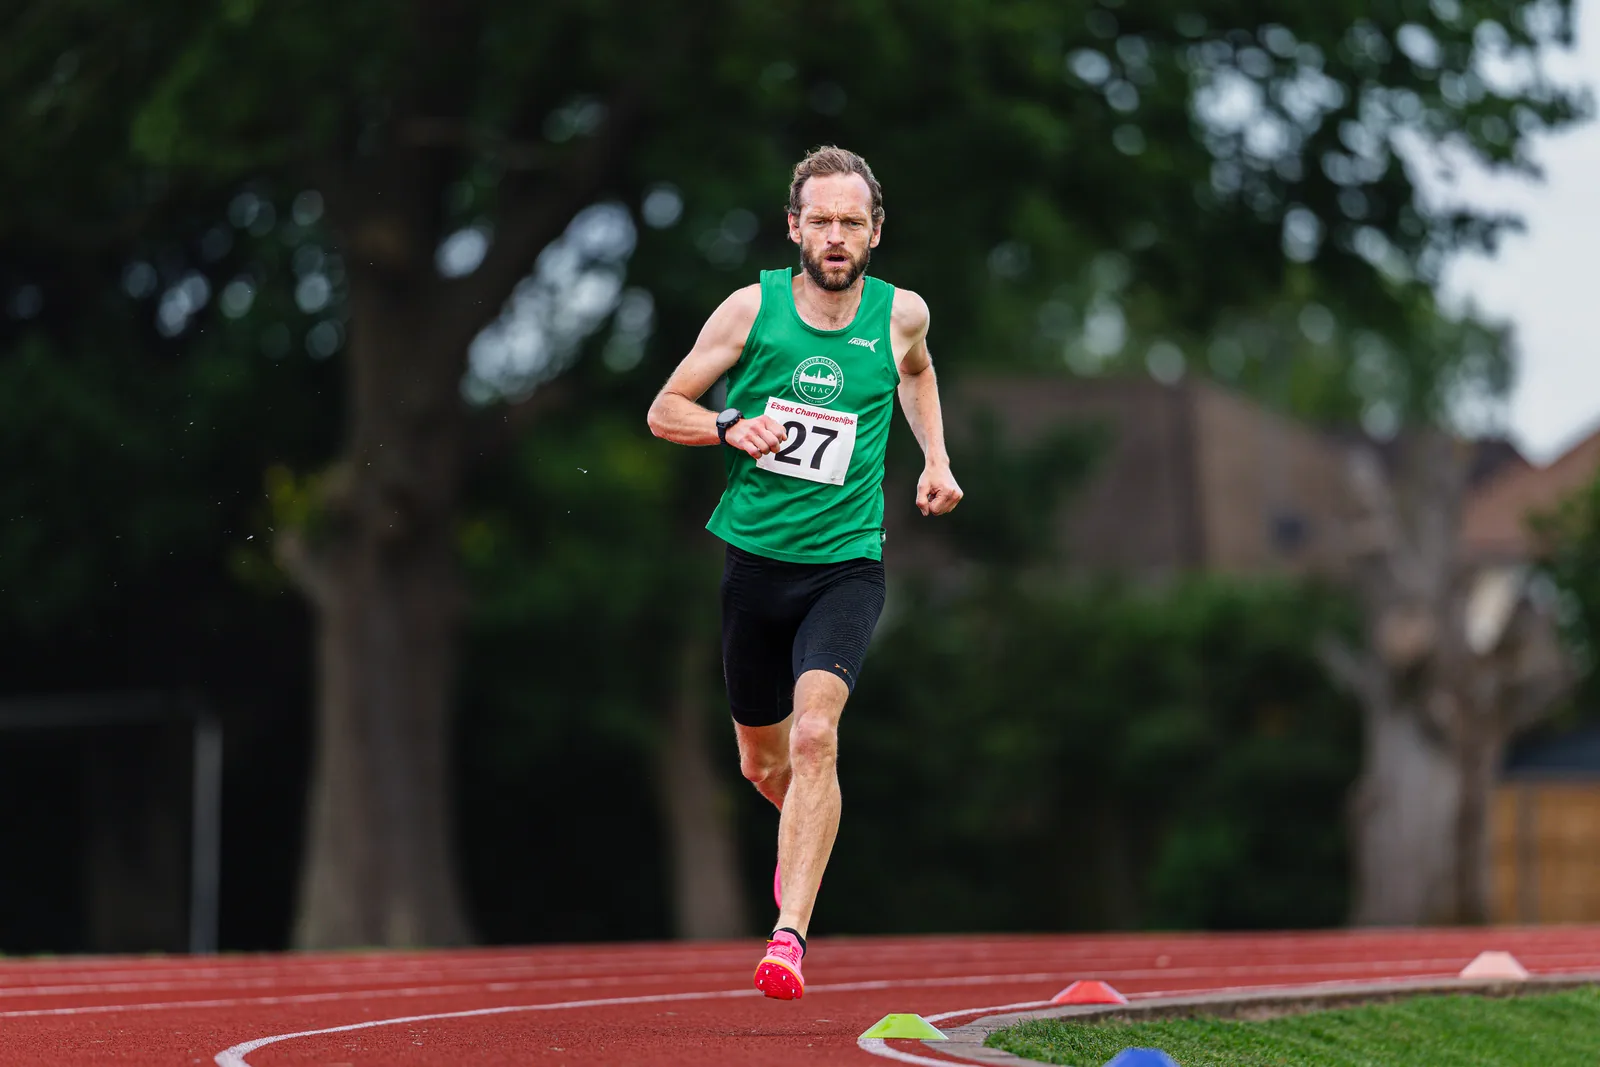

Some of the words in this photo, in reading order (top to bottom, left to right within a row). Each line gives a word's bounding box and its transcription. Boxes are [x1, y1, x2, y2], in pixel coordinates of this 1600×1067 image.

[794, 358, 820, 384] COLCHESTER
[820, 358, 842, 379] HARRIERS
[803, 385, 831, 395] CHAC
[770, 401, 794, 414] Essex
[795, 407, 855, 425] Championships
[774, 420, 839, 470] 27
